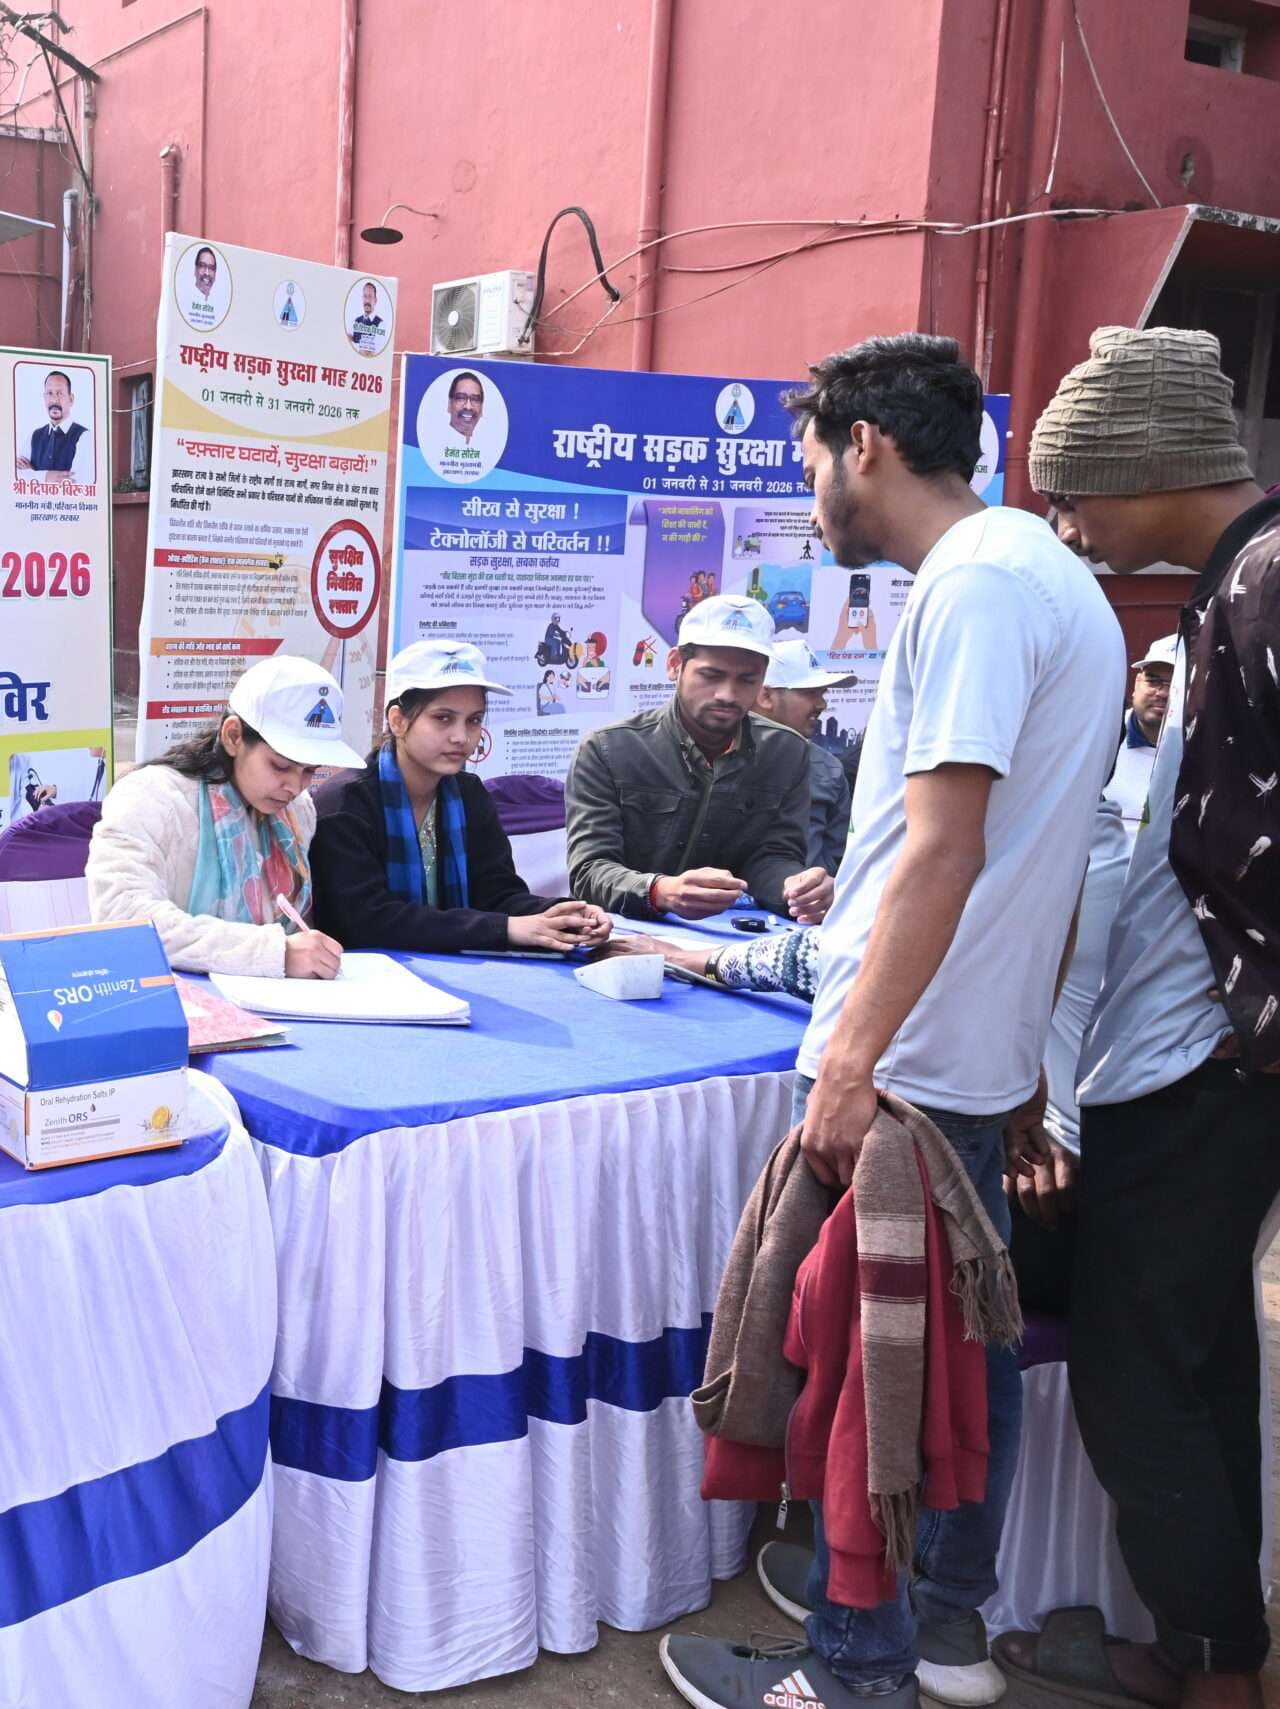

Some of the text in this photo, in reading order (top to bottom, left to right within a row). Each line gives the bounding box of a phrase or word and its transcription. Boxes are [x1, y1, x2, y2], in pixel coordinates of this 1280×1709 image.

[179, 343, 383, 394] राष्ट्रीय सड़क सुरक्षा माह 2026
[202, 388, 360, 420] 01 जनवरी से 31 जनवरी 2026 तक
[285, 451, 326, 473] सुरक्षा
[552, 423, 786, 475] राष्ट्रीय सड़क सुरक्षा
[642, 475, 793, 494] 01 जनवरी से 31 जनवरी 2026
[462, 497, 580, 525] सीख से सुरक्षा !
[430, 530, 610, 552] टेक्नोलॉजी से परिवर्तन !!
[328, 545, 364, 571] सुरक्षित
[469, 555, 489, 568] सड़क
[490, 556, 515, 570] सुरक्षा,
[1, 552, 92, 598] 2026
[53, 978, 138, 1006] Zenith ORS
[40, 1096, 54, 1106] Oral
[55, 1092, 92, 1106] Rehydration
[92, 1090, 108, 1100] Salts
[44, 1111, 88, 1128] Zenith ORS
